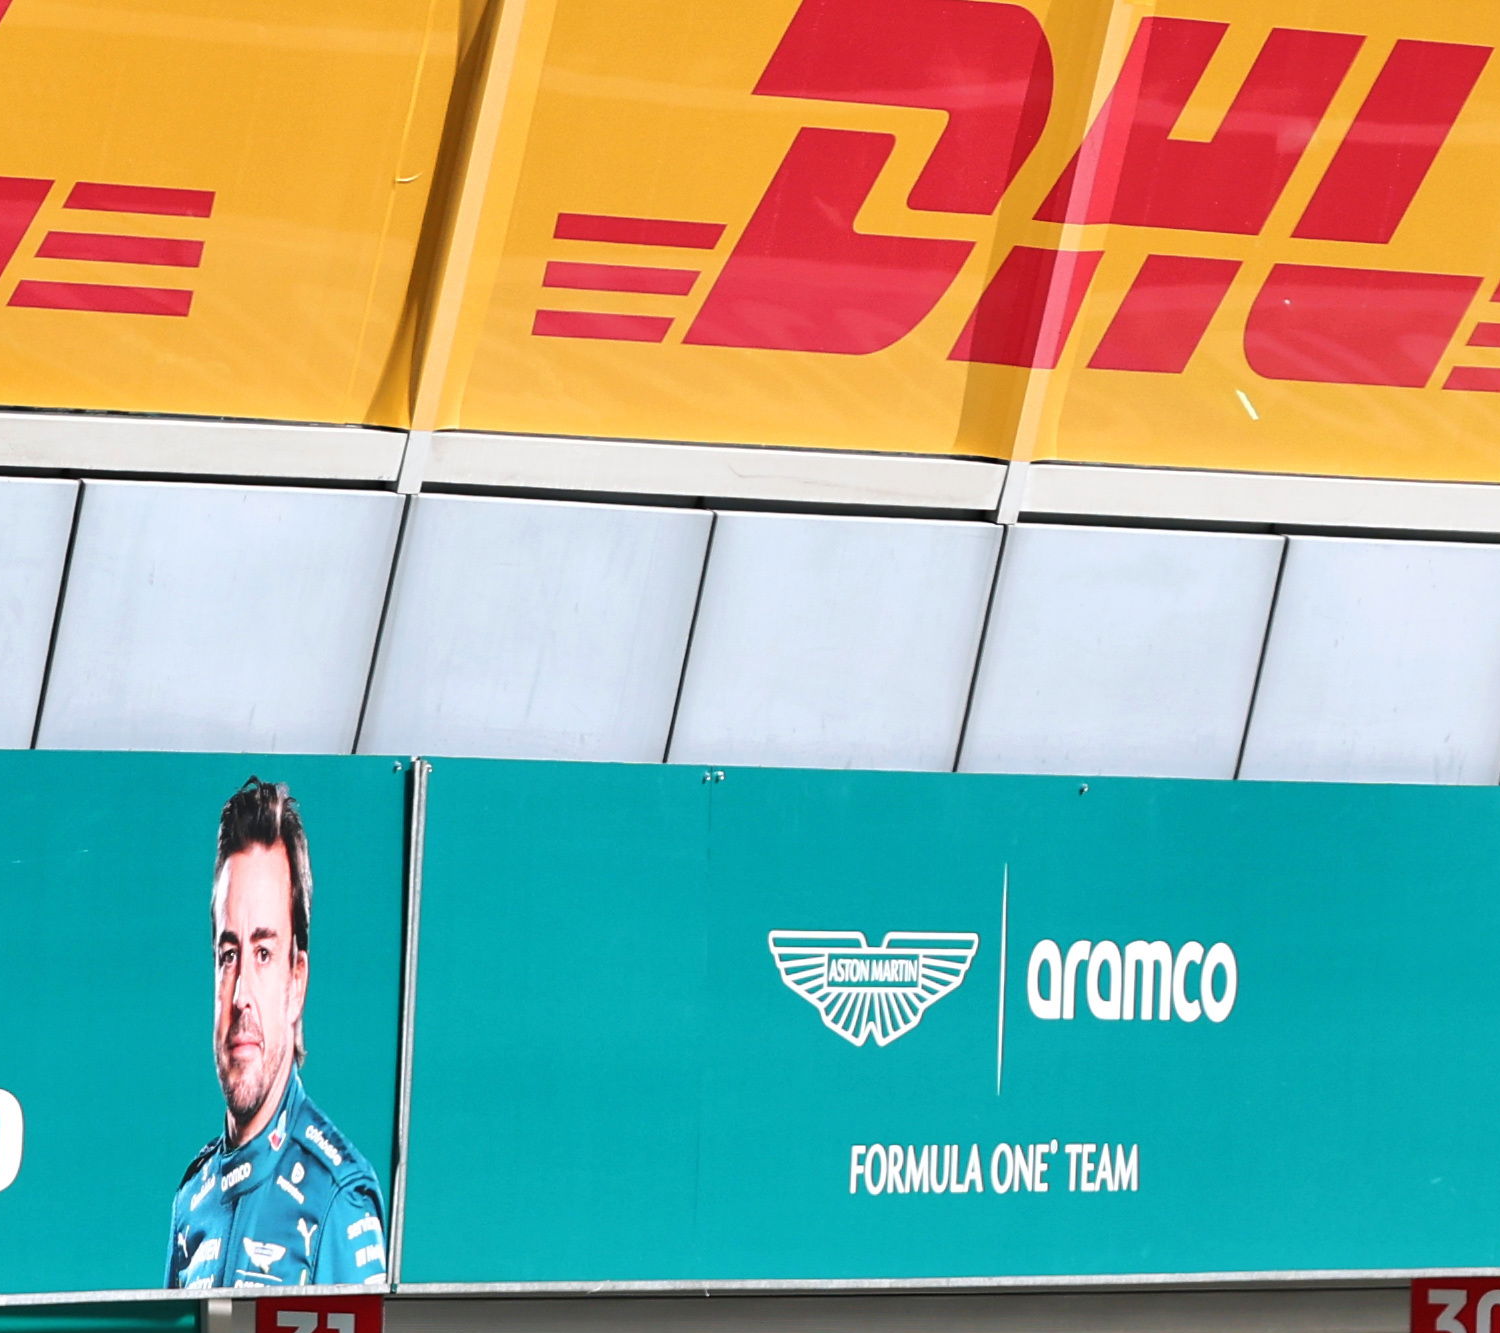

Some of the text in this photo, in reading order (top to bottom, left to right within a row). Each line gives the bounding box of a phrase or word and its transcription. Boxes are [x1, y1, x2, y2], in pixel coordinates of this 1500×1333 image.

[685, 0, 1494, 388] DHL
[828, 958, 919, 984] ASTON MARTIN
[1026, 938, 1238, 1024] aramco
[849, 1143, 984, 1196] FORMULA
[1065, 1143, 1139, 1192] TEAM
